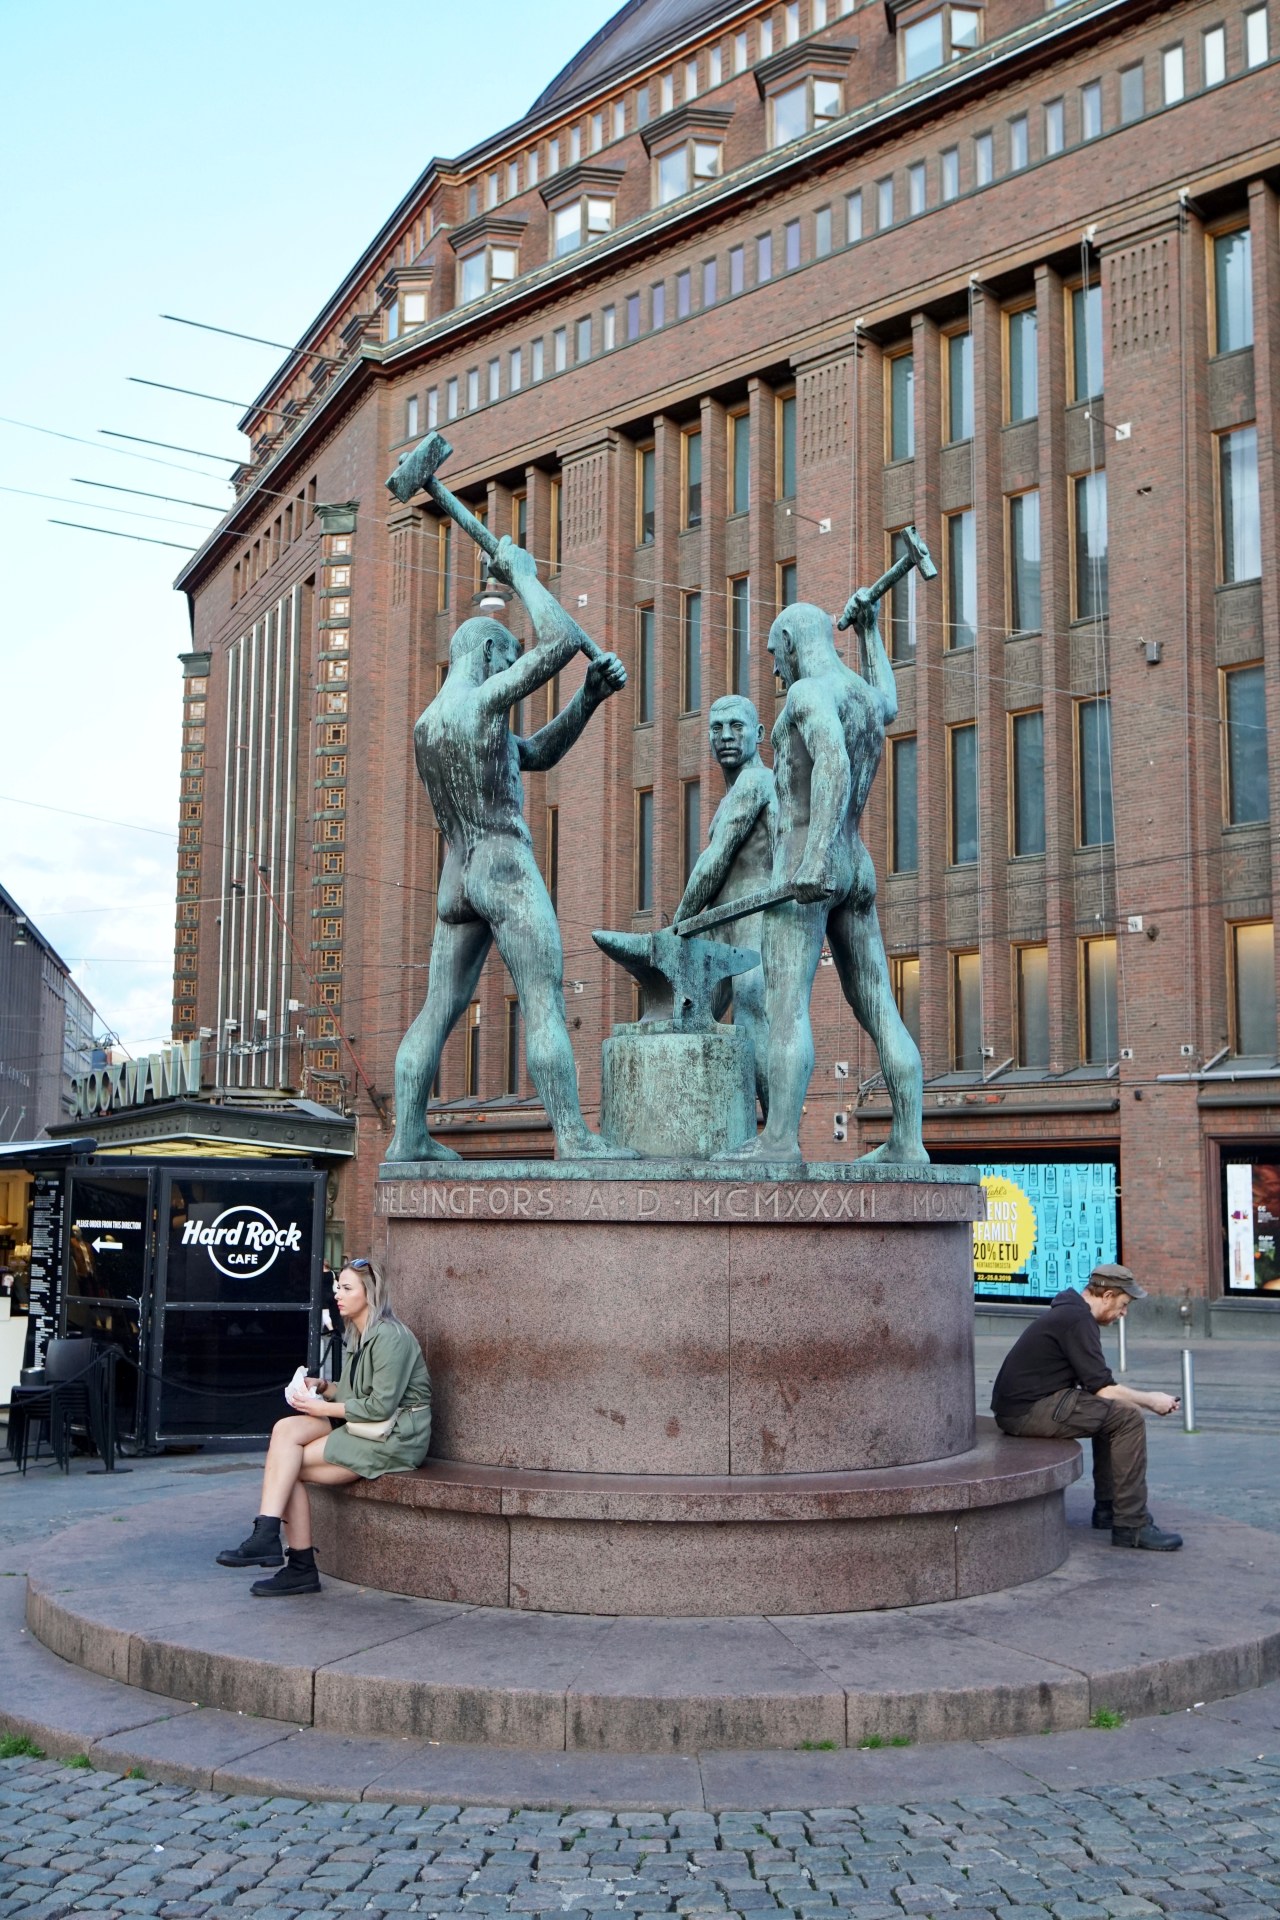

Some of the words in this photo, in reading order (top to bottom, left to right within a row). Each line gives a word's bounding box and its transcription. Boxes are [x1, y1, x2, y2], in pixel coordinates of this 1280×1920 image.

[69, 1040, 201, 1118] STOCKMANN
[381, 1186, 554, 1216] HELSINGFORS
[583, 1189, 608, 1216] A
[637, 1189, 661, 1216] D
[692, 1188, 876, 1218] MCMXXXII
[76, 1219, 90, 1228] PLEASE
[977, 1222, 1017, 1242] FAMILY
[181, 1220, 245, 1245] Hard
[245, 1221, 302, 1251] Rock
[227, 1254, 258, 1264] CAFE
[999, 1243, 1018, 1261] ETU
